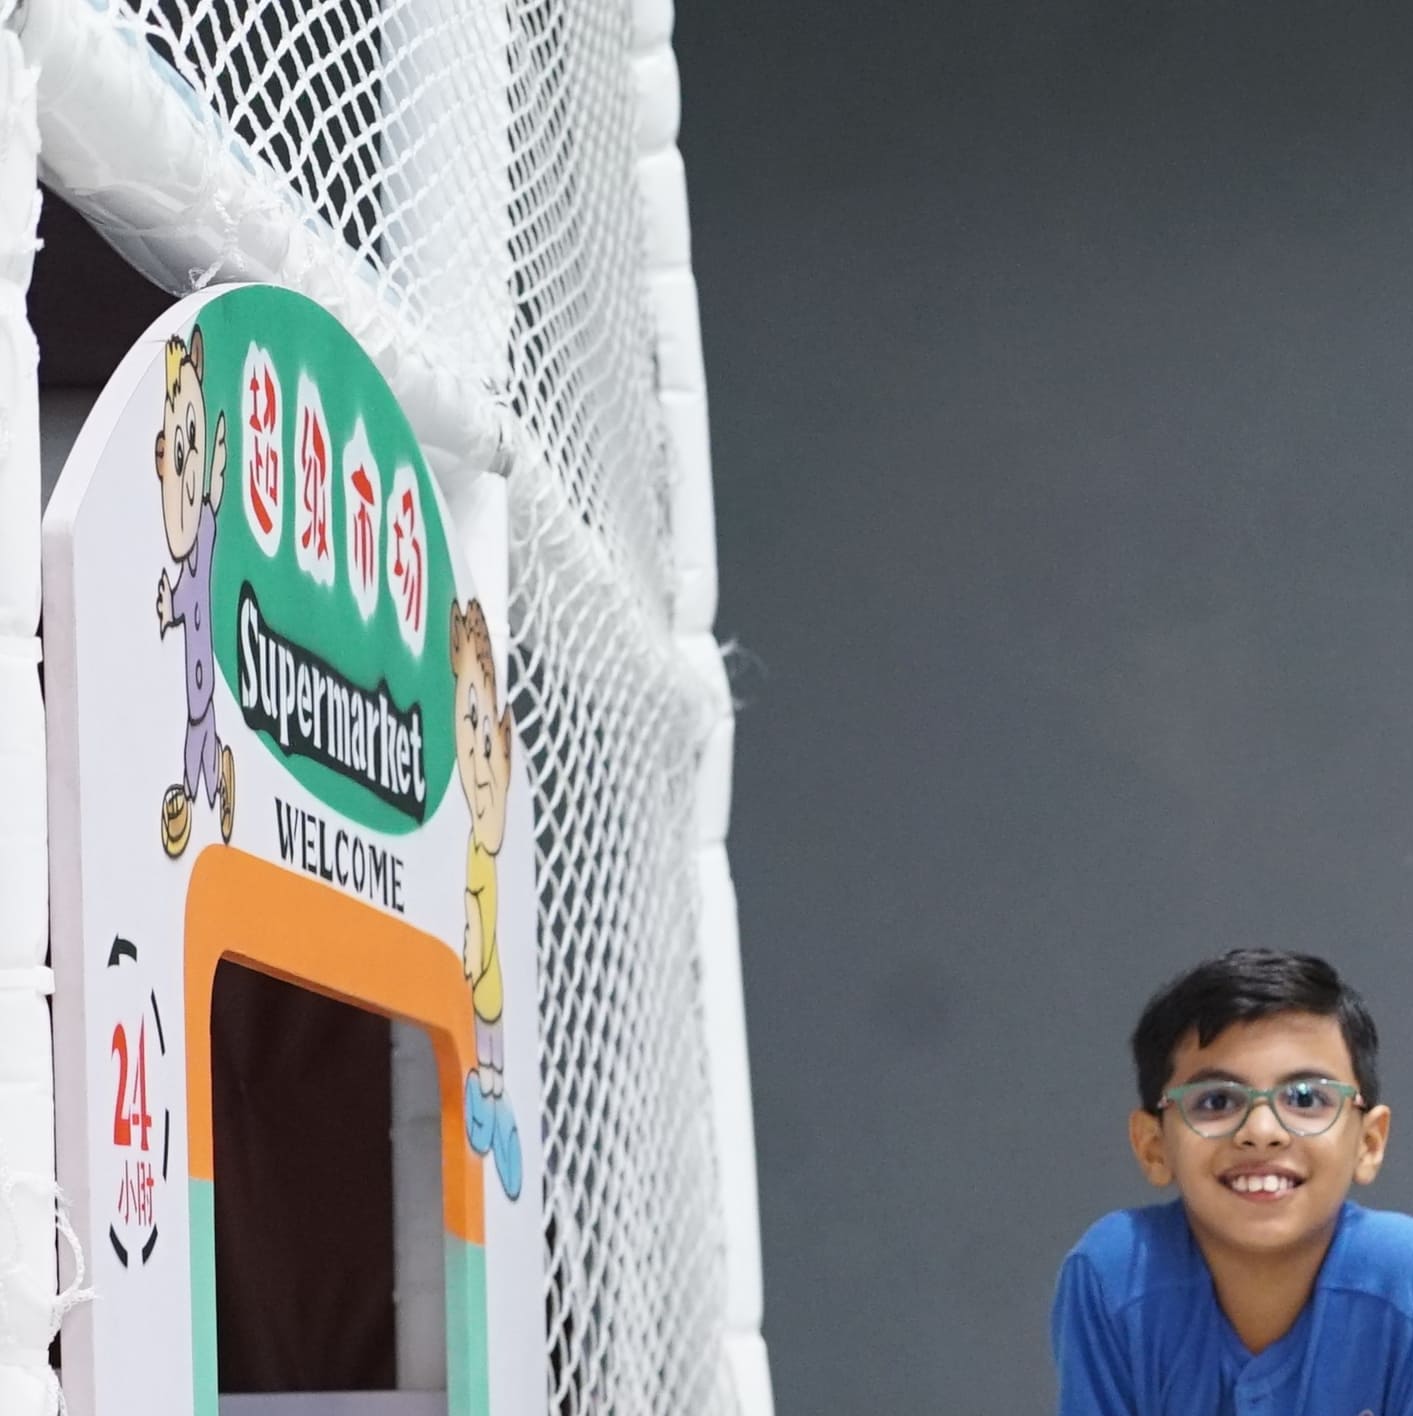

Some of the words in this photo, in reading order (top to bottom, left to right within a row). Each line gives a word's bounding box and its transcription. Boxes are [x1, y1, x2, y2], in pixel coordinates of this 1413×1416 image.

[247, 360, 422, 633] 超级市场
[240, 597, 426, 803] Supermarket
[274, 796, 405, 913] WELCOME
[110, 1012, 152, 1151] 24
[118, 1159, 155, 1227] 小时
